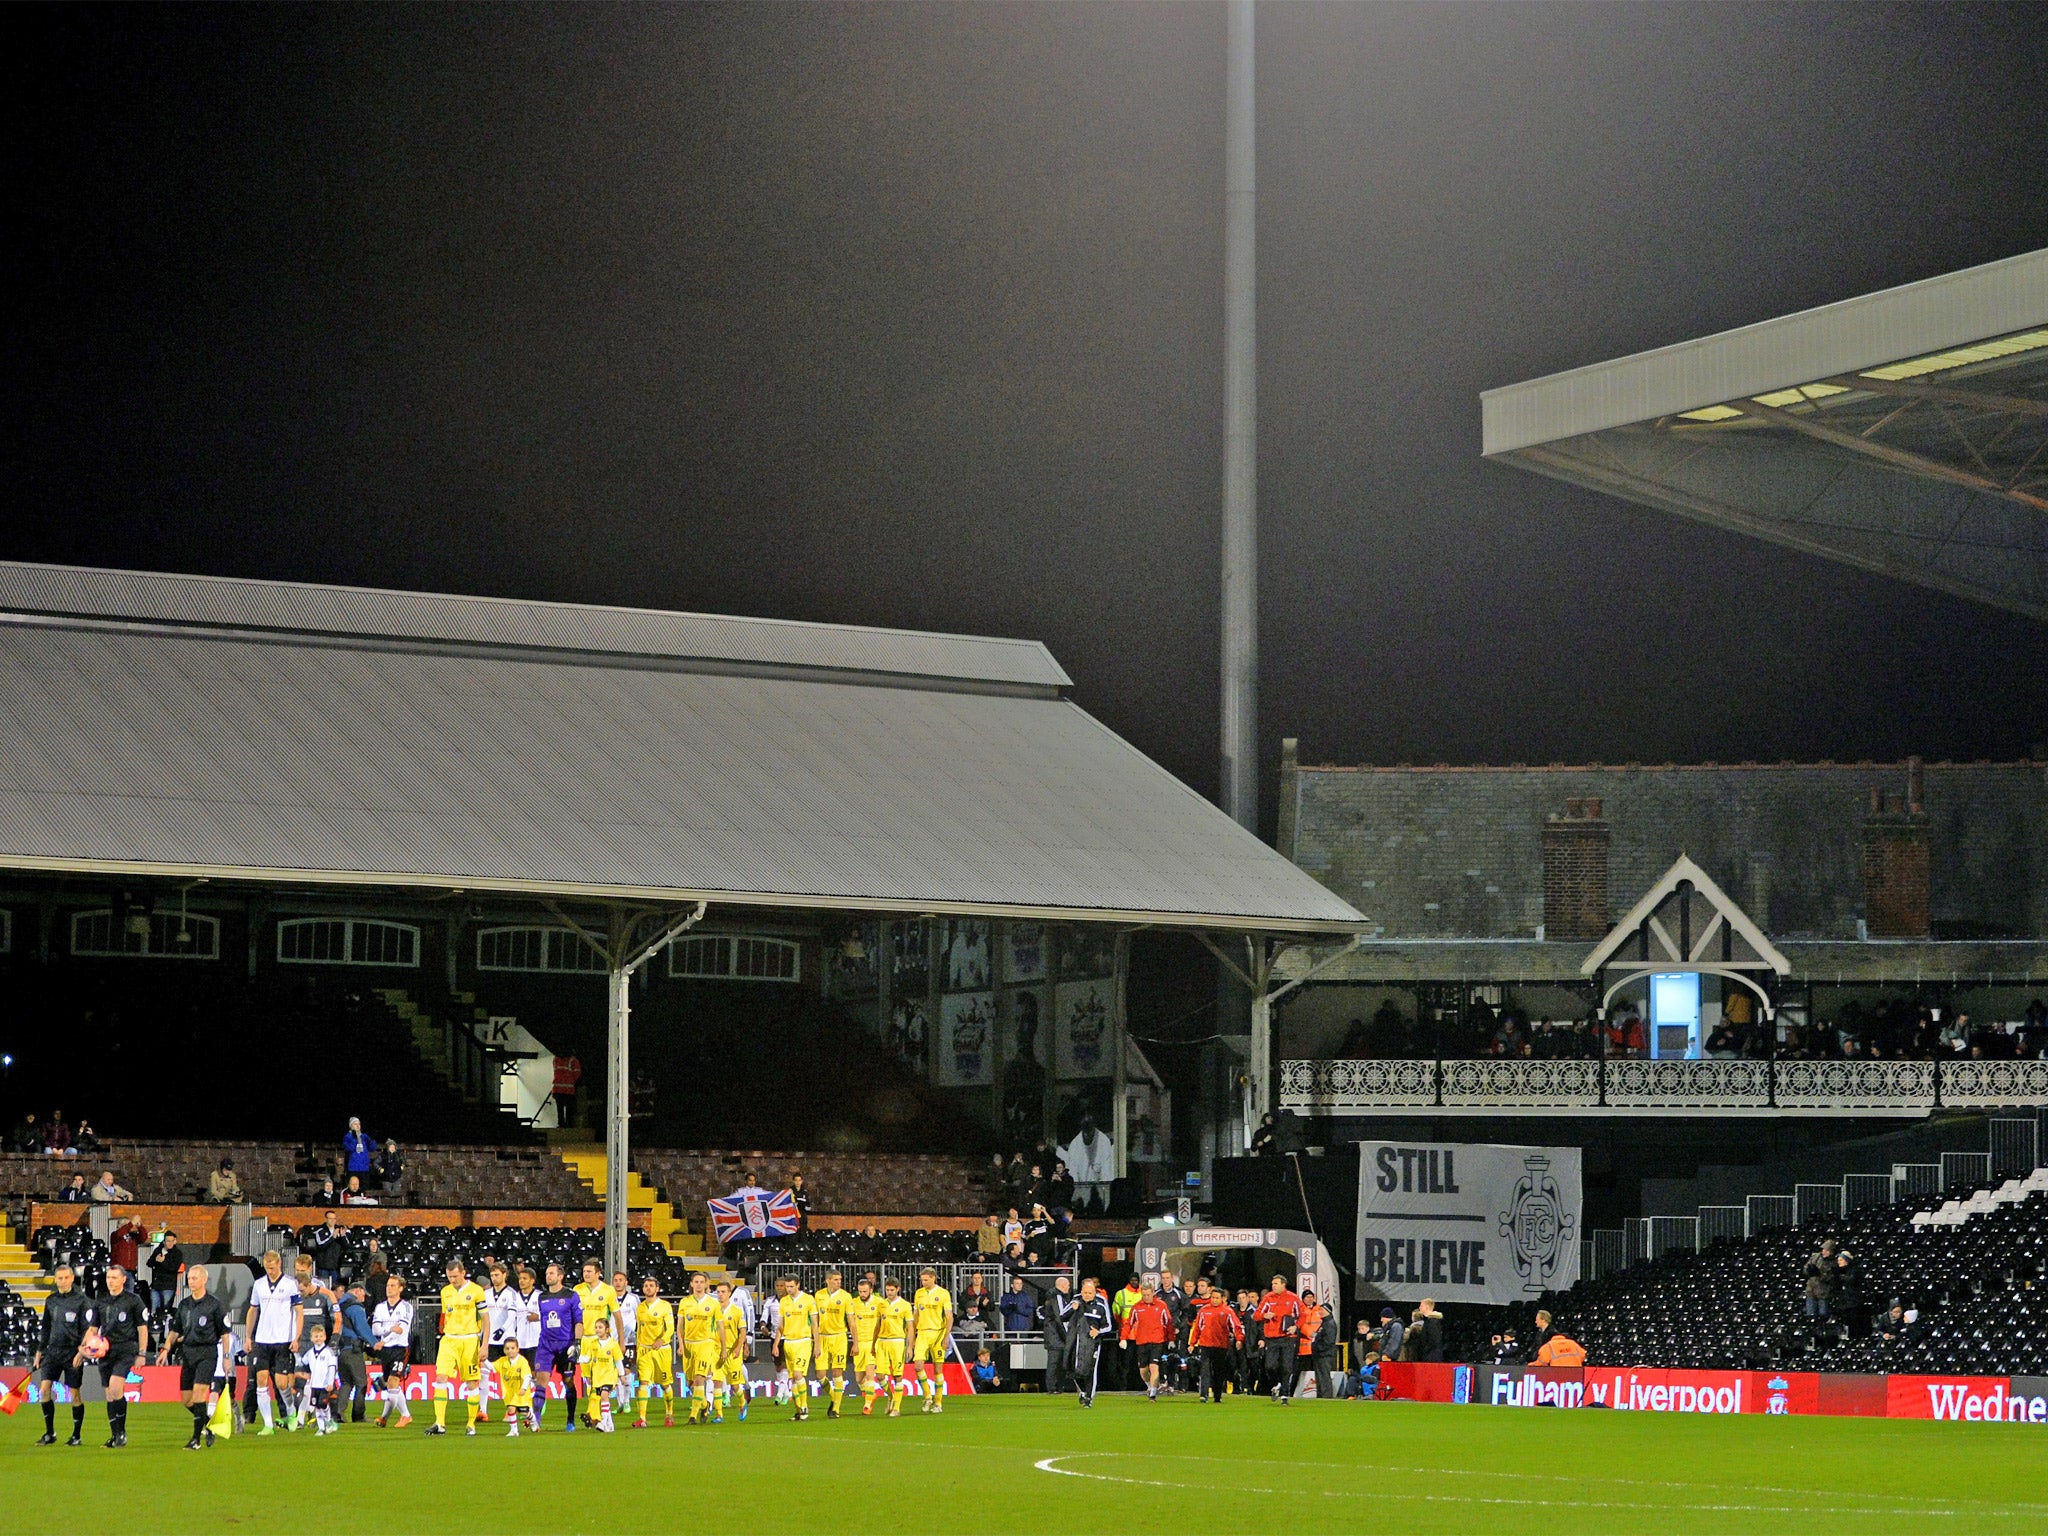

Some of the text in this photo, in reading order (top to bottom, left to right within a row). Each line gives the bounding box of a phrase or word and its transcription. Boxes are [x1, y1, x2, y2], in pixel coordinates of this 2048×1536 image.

[493, 1020, 511, 1040] K
[1376, 1147, 1459, 1194] STILL
[1196, 1233, 1255, 1241] MARATHON
[1364, 1237, 1485, 1286] BELIEVE
[624, 1349, 634, 1358] 43
[392, 1361, 404, 1372] 28
[468, 1365, 478, 1375] 15
[698, 1361, 706, 1369] 14
[732, 1371, 741, 1379] 21
[1492, 1372, 1742, 1413] Fulham v Liverpool
